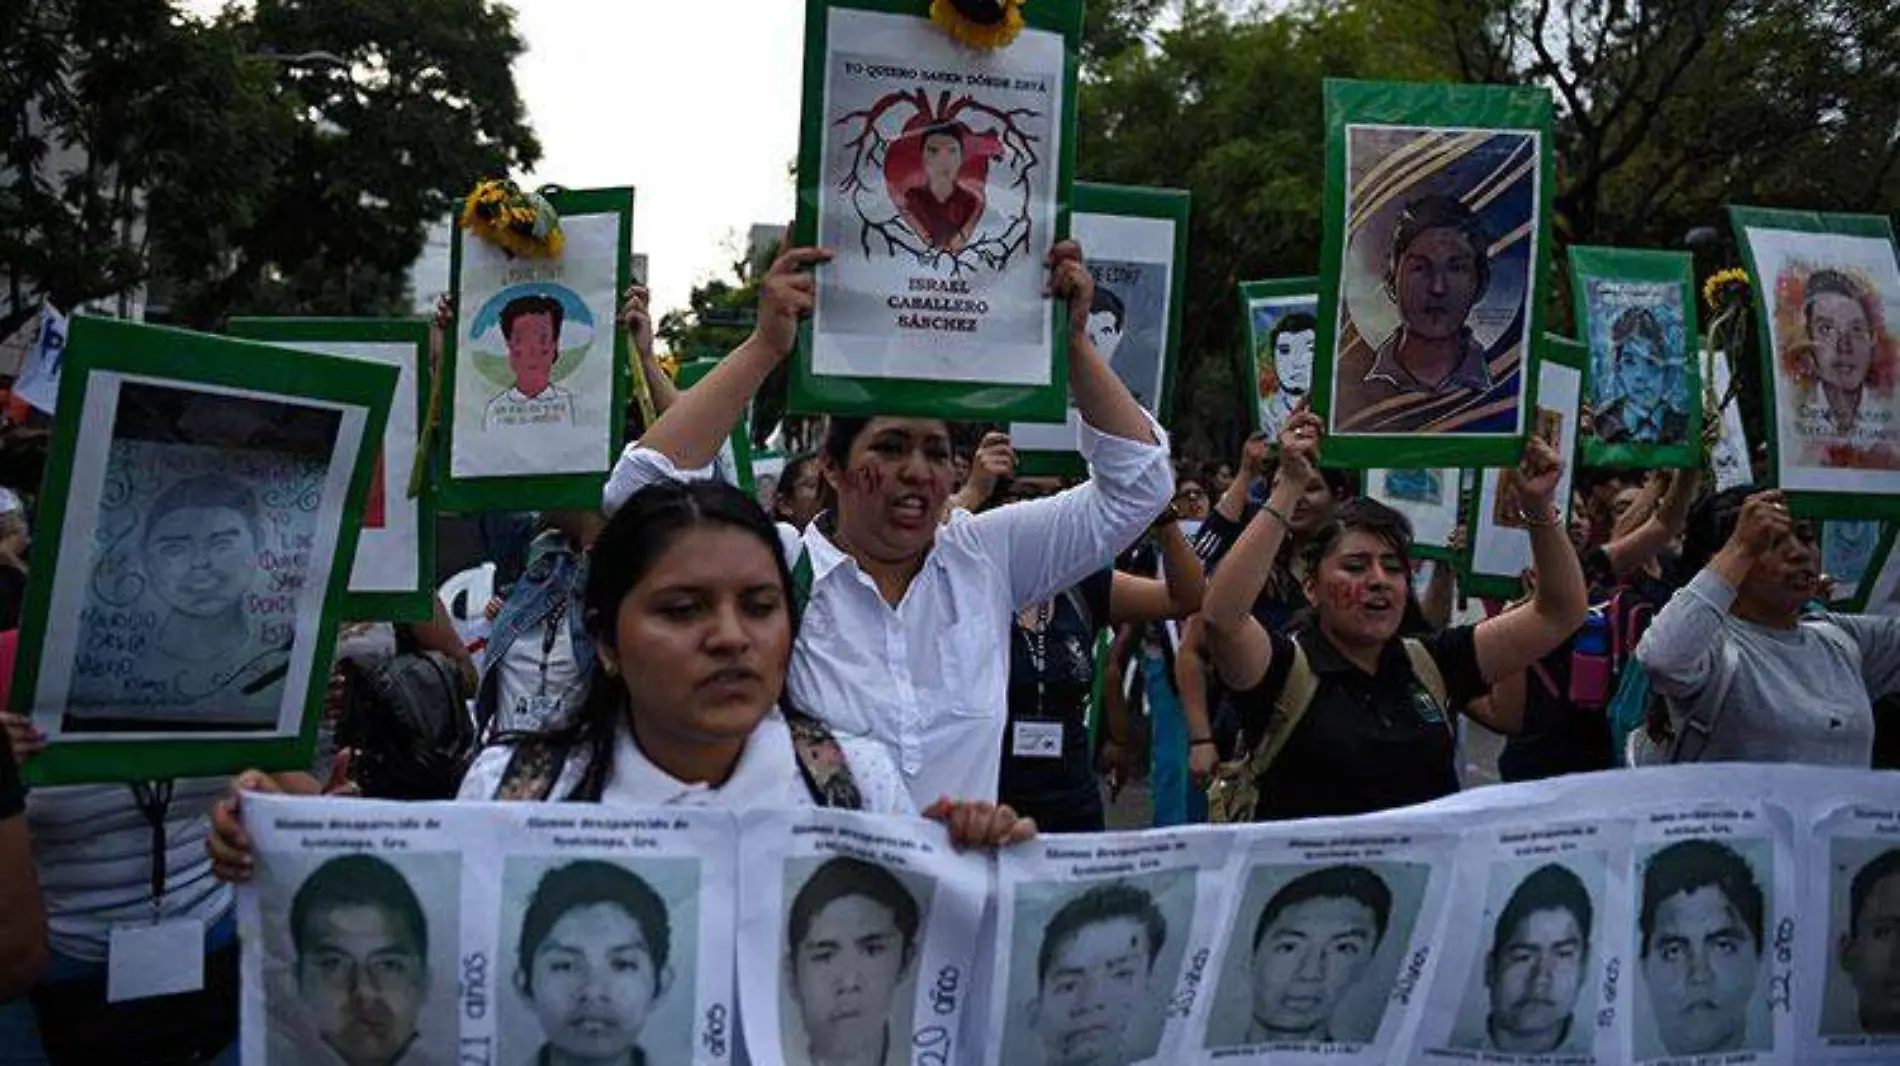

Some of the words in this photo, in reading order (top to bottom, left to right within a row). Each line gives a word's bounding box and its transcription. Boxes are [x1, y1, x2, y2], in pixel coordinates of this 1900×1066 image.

[866, 64, 917, 79] QUIERO
[922, 69, 963, 84] SABER
[908, 277, 970, 295] ISRAEL
[886, 295, 989, 314] CABALLERO
[898, 312, 978, 332] SÁNCHEZ
[458, 952, 488, 1020] años
[927, 965, 960, 1016] años
[701, 1003, 726, 1058] años
